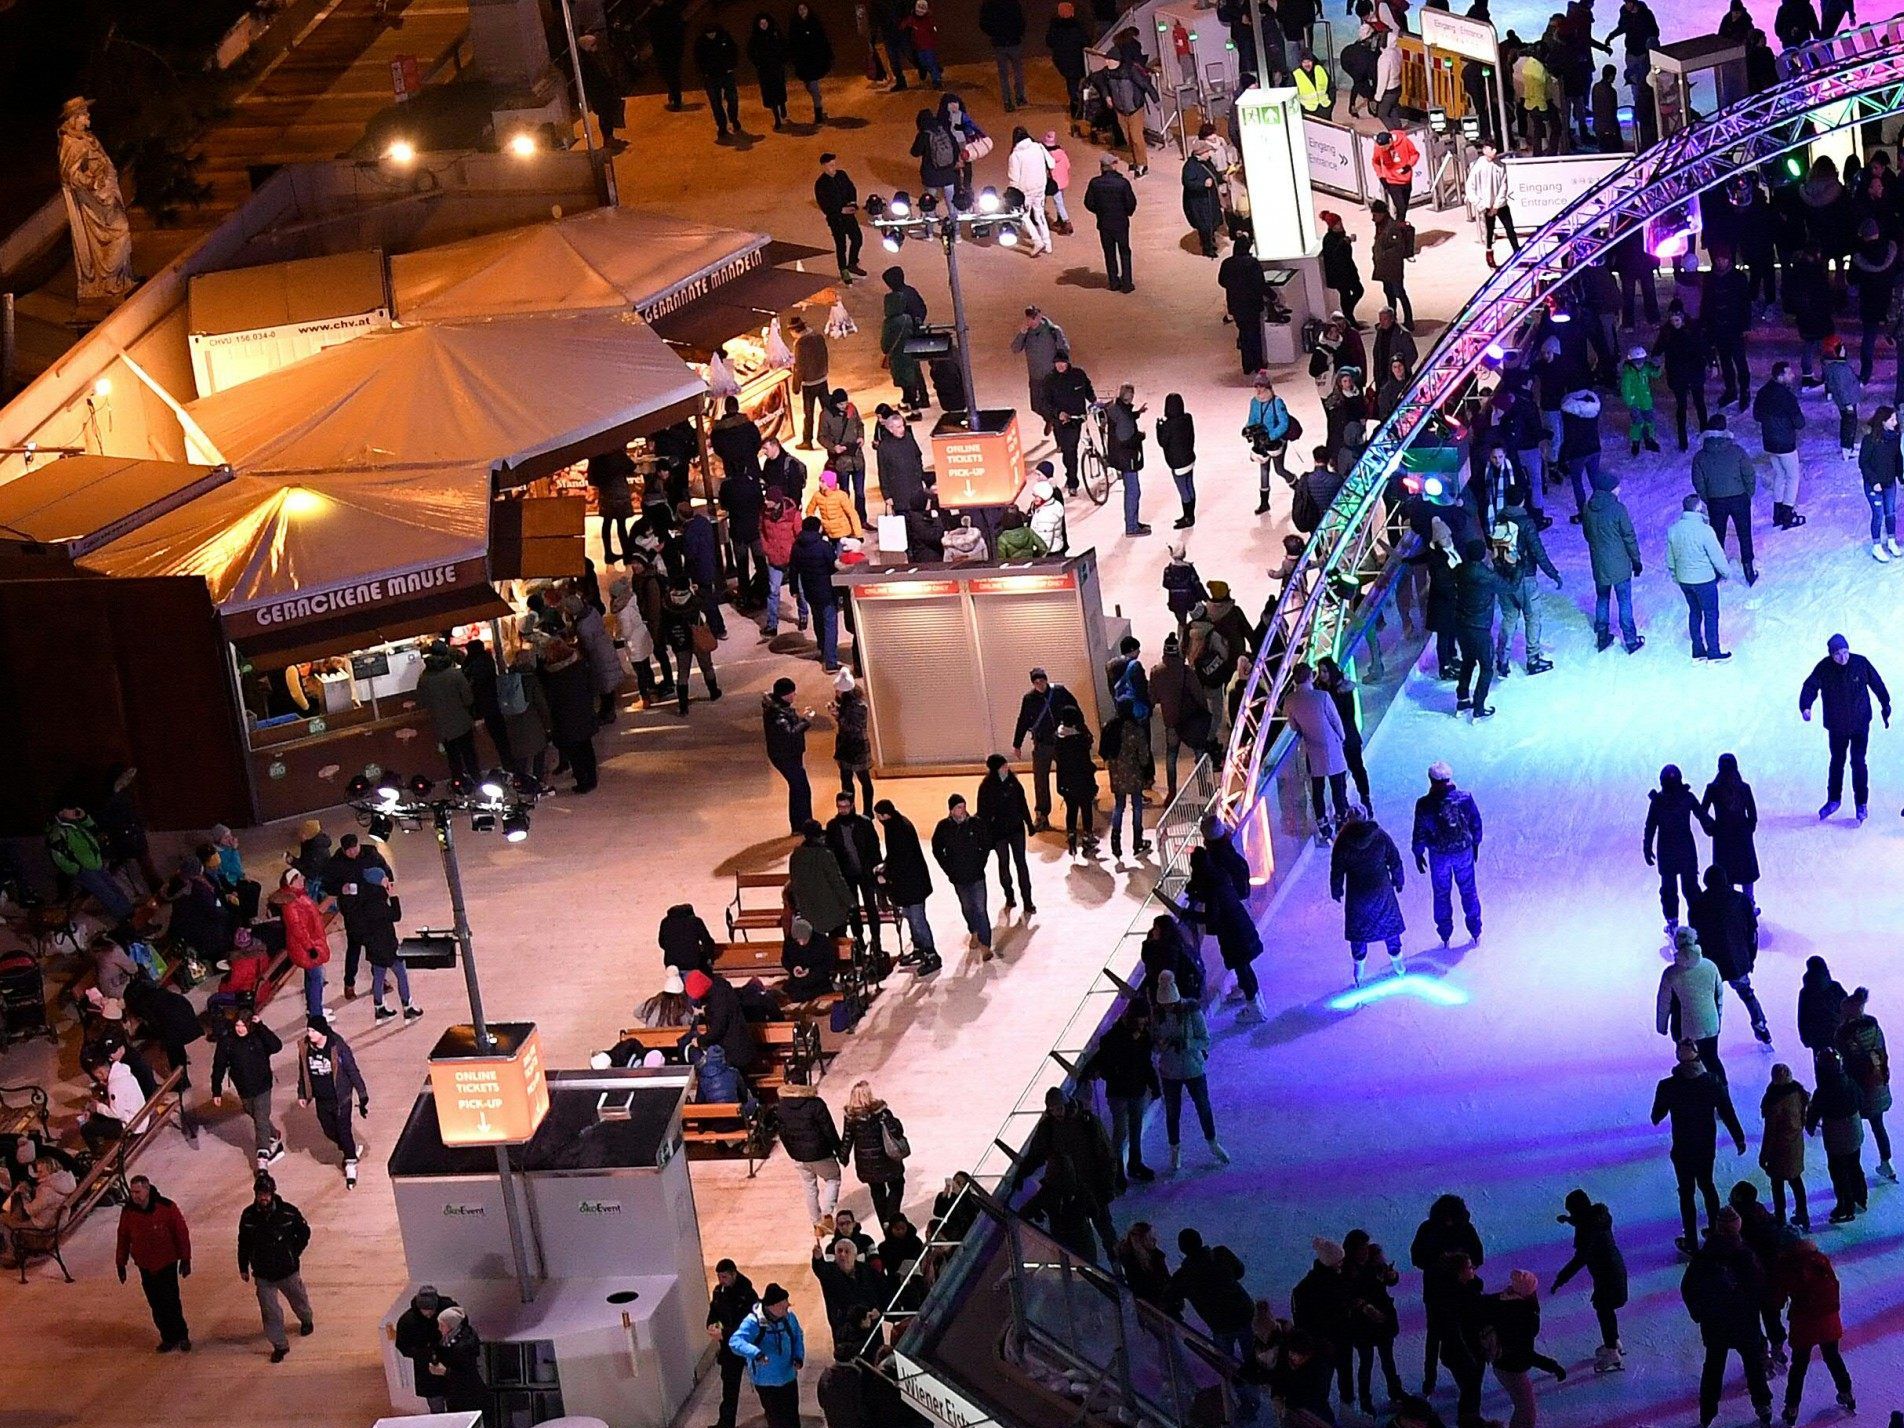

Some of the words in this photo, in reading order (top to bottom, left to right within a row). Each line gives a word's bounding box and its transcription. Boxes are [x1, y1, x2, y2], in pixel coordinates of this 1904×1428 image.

[1309, 137, 1336, 156] Eingang
[1519, 183, 1562, 194] Eingang
[1520, 198, 1567, 207] Entrance
[298, 317, 371, 334] www.chv.at
[946, 444, 981, 453] ONLINE
[947, 454, 983, 463] TICKETS
[948, 468, 985, 477] PICK-UP
[256, 581, 382, 626] GEBACKENE
[455, 1071, 496, 1081] ONLINE
[456, 1083, 499, 1093] TICKETS
[458, 1099, 503, 1109] PICK-UP
[902, 1367, 944, 1416] Wiener
